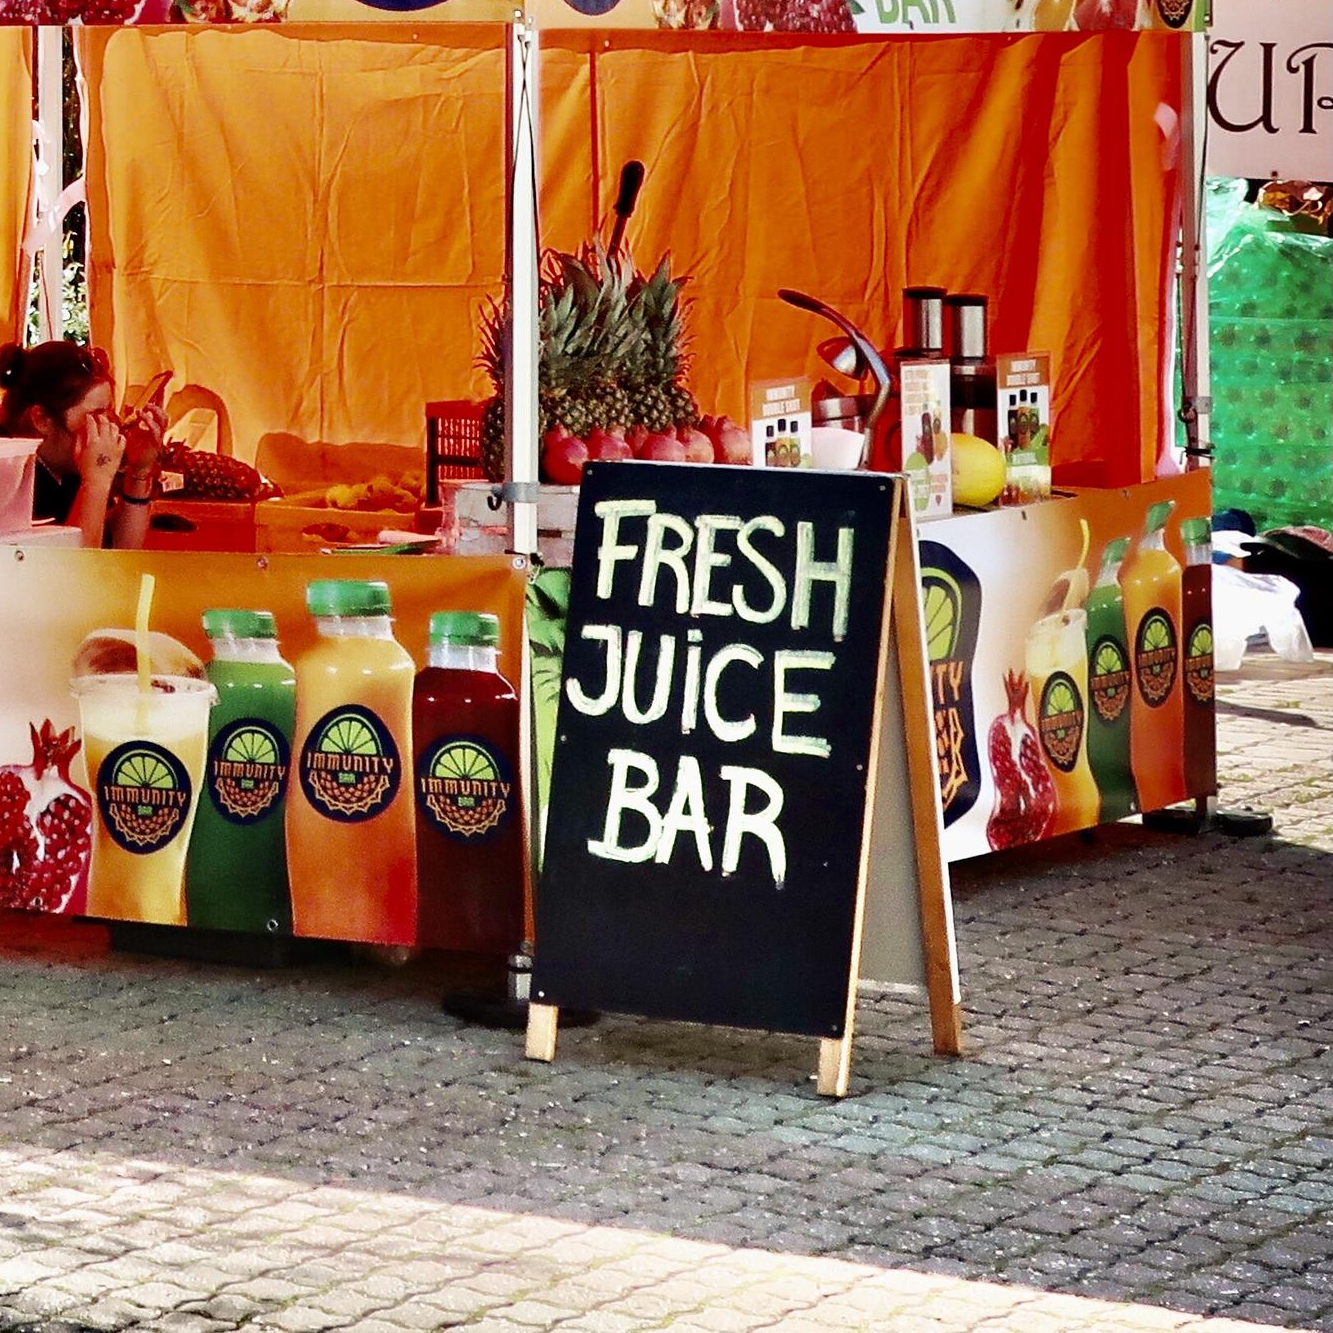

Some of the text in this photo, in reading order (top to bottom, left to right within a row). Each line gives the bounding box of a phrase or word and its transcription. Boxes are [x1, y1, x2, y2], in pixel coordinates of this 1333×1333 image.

[594, 499, 854, 642] FRESH
[214, 760, 286, 781] IMMUNITY
[307, 752, 394, 774] IMMUNITY
[104, 785, 187, 807] IMMUNITY
[421, 777, 511, 799] IMMUNITY
[587, 748, 786, 889] BAR
